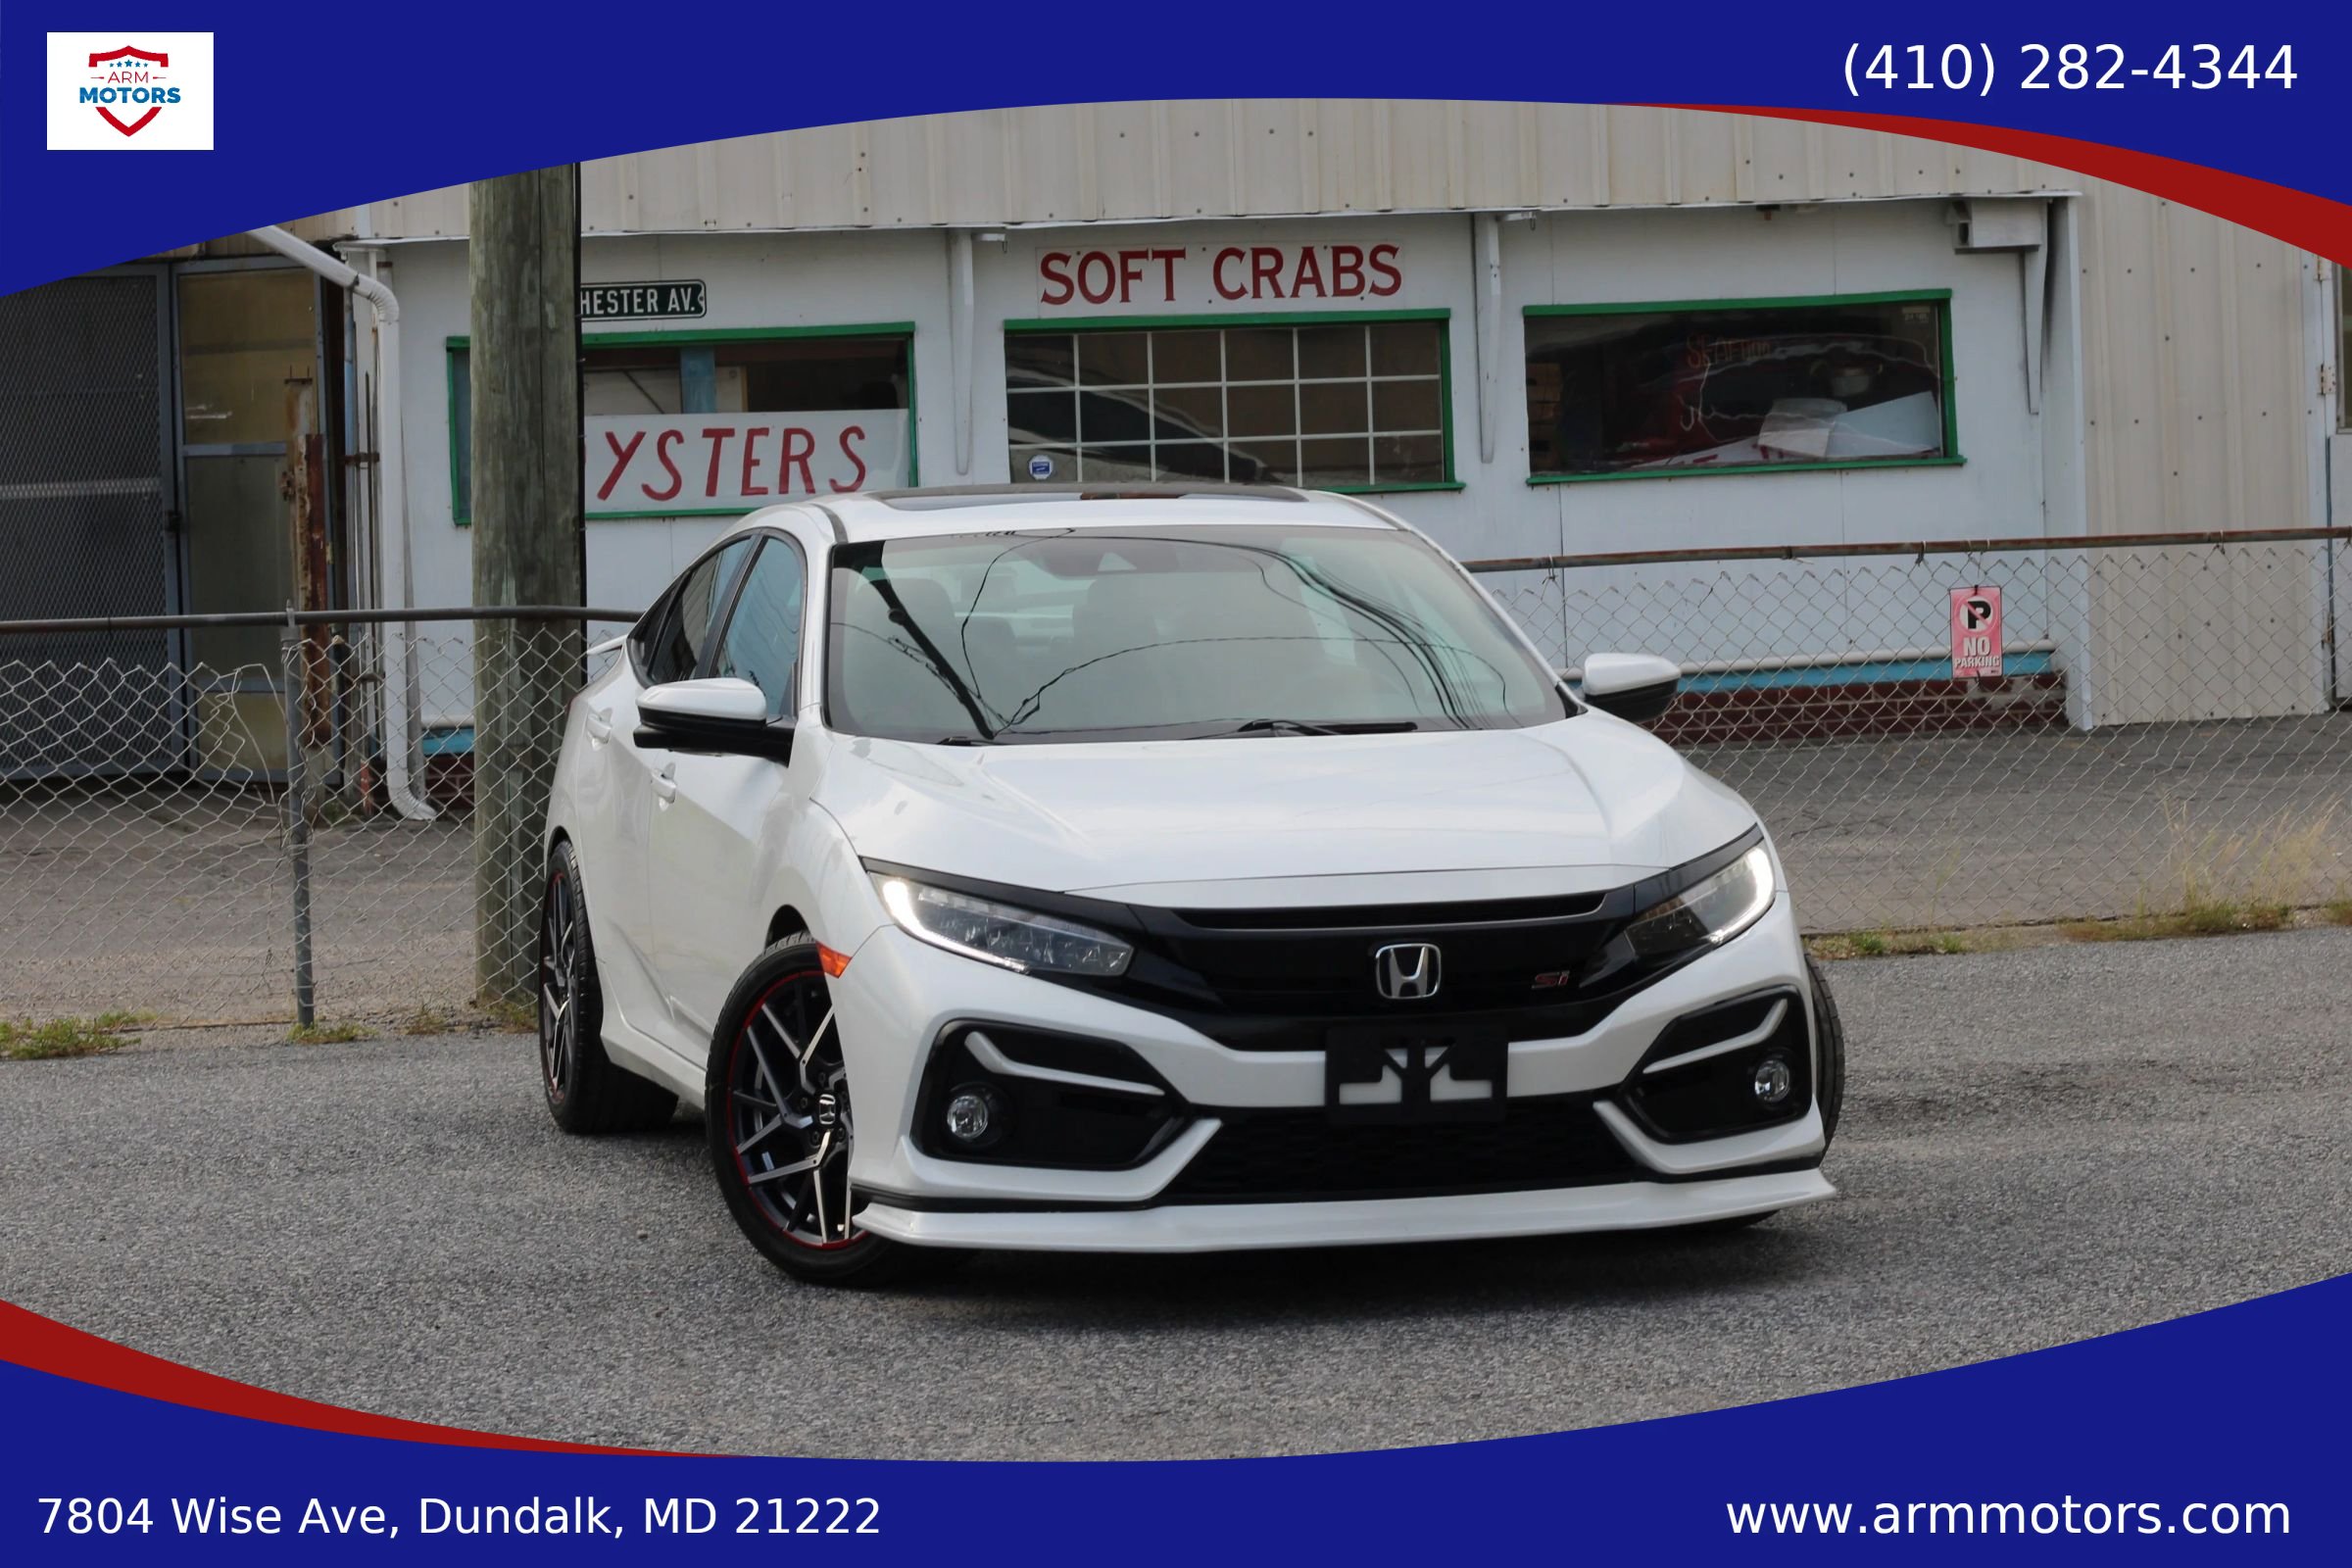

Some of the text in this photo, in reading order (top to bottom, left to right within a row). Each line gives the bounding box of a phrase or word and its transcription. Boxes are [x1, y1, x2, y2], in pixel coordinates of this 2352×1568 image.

[1040, 244, 1402, 305] SOFT CRABS
[667, 287, 695, 313] AV.
[584, 425, 866, 502] YSTERS
[1963, 636, 1991, 657] NO
[1954, 655, 2000, 668] PARKING
